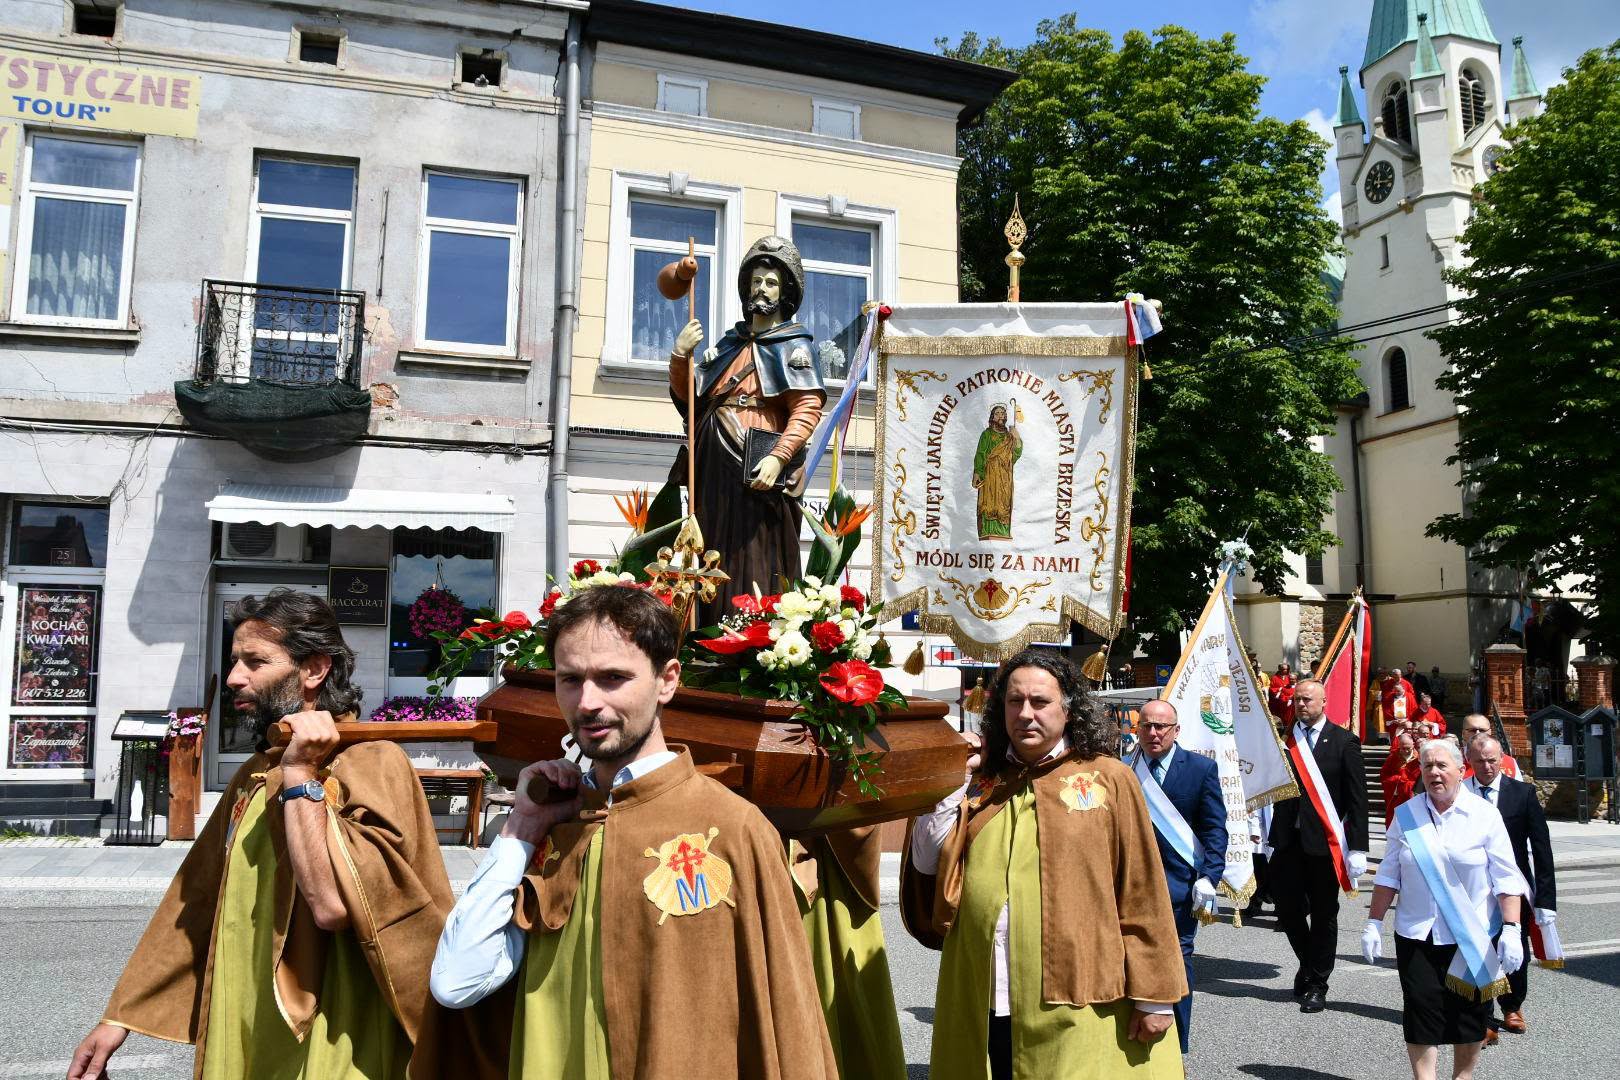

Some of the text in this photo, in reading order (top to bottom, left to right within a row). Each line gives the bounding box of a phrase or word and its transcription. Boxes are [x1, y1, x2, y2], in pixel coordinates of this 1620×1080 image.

[12, 95, 111, 121] TOUR"
[921, 367, 1076, 546] ŚWIĘTY JAKUBIE PATRONIE MIASTA BRZESKA
[915, 549, 1080, 573] MÓDL SIĘ ZA NAMI
[331, 598, 384, 608] BACCARAT
[31, 619, 88, 631] KOCHAĆ
[26, 634, 89, 645] KWIATAMI
[72, 668, 79, 677] 5
[22, 687, 87, 698] 607 532 226
[1229, 659, 1251, 713] JEZUSA
[1226, 850, 1250, 863] 009
[675, 873, 711, 912] M
